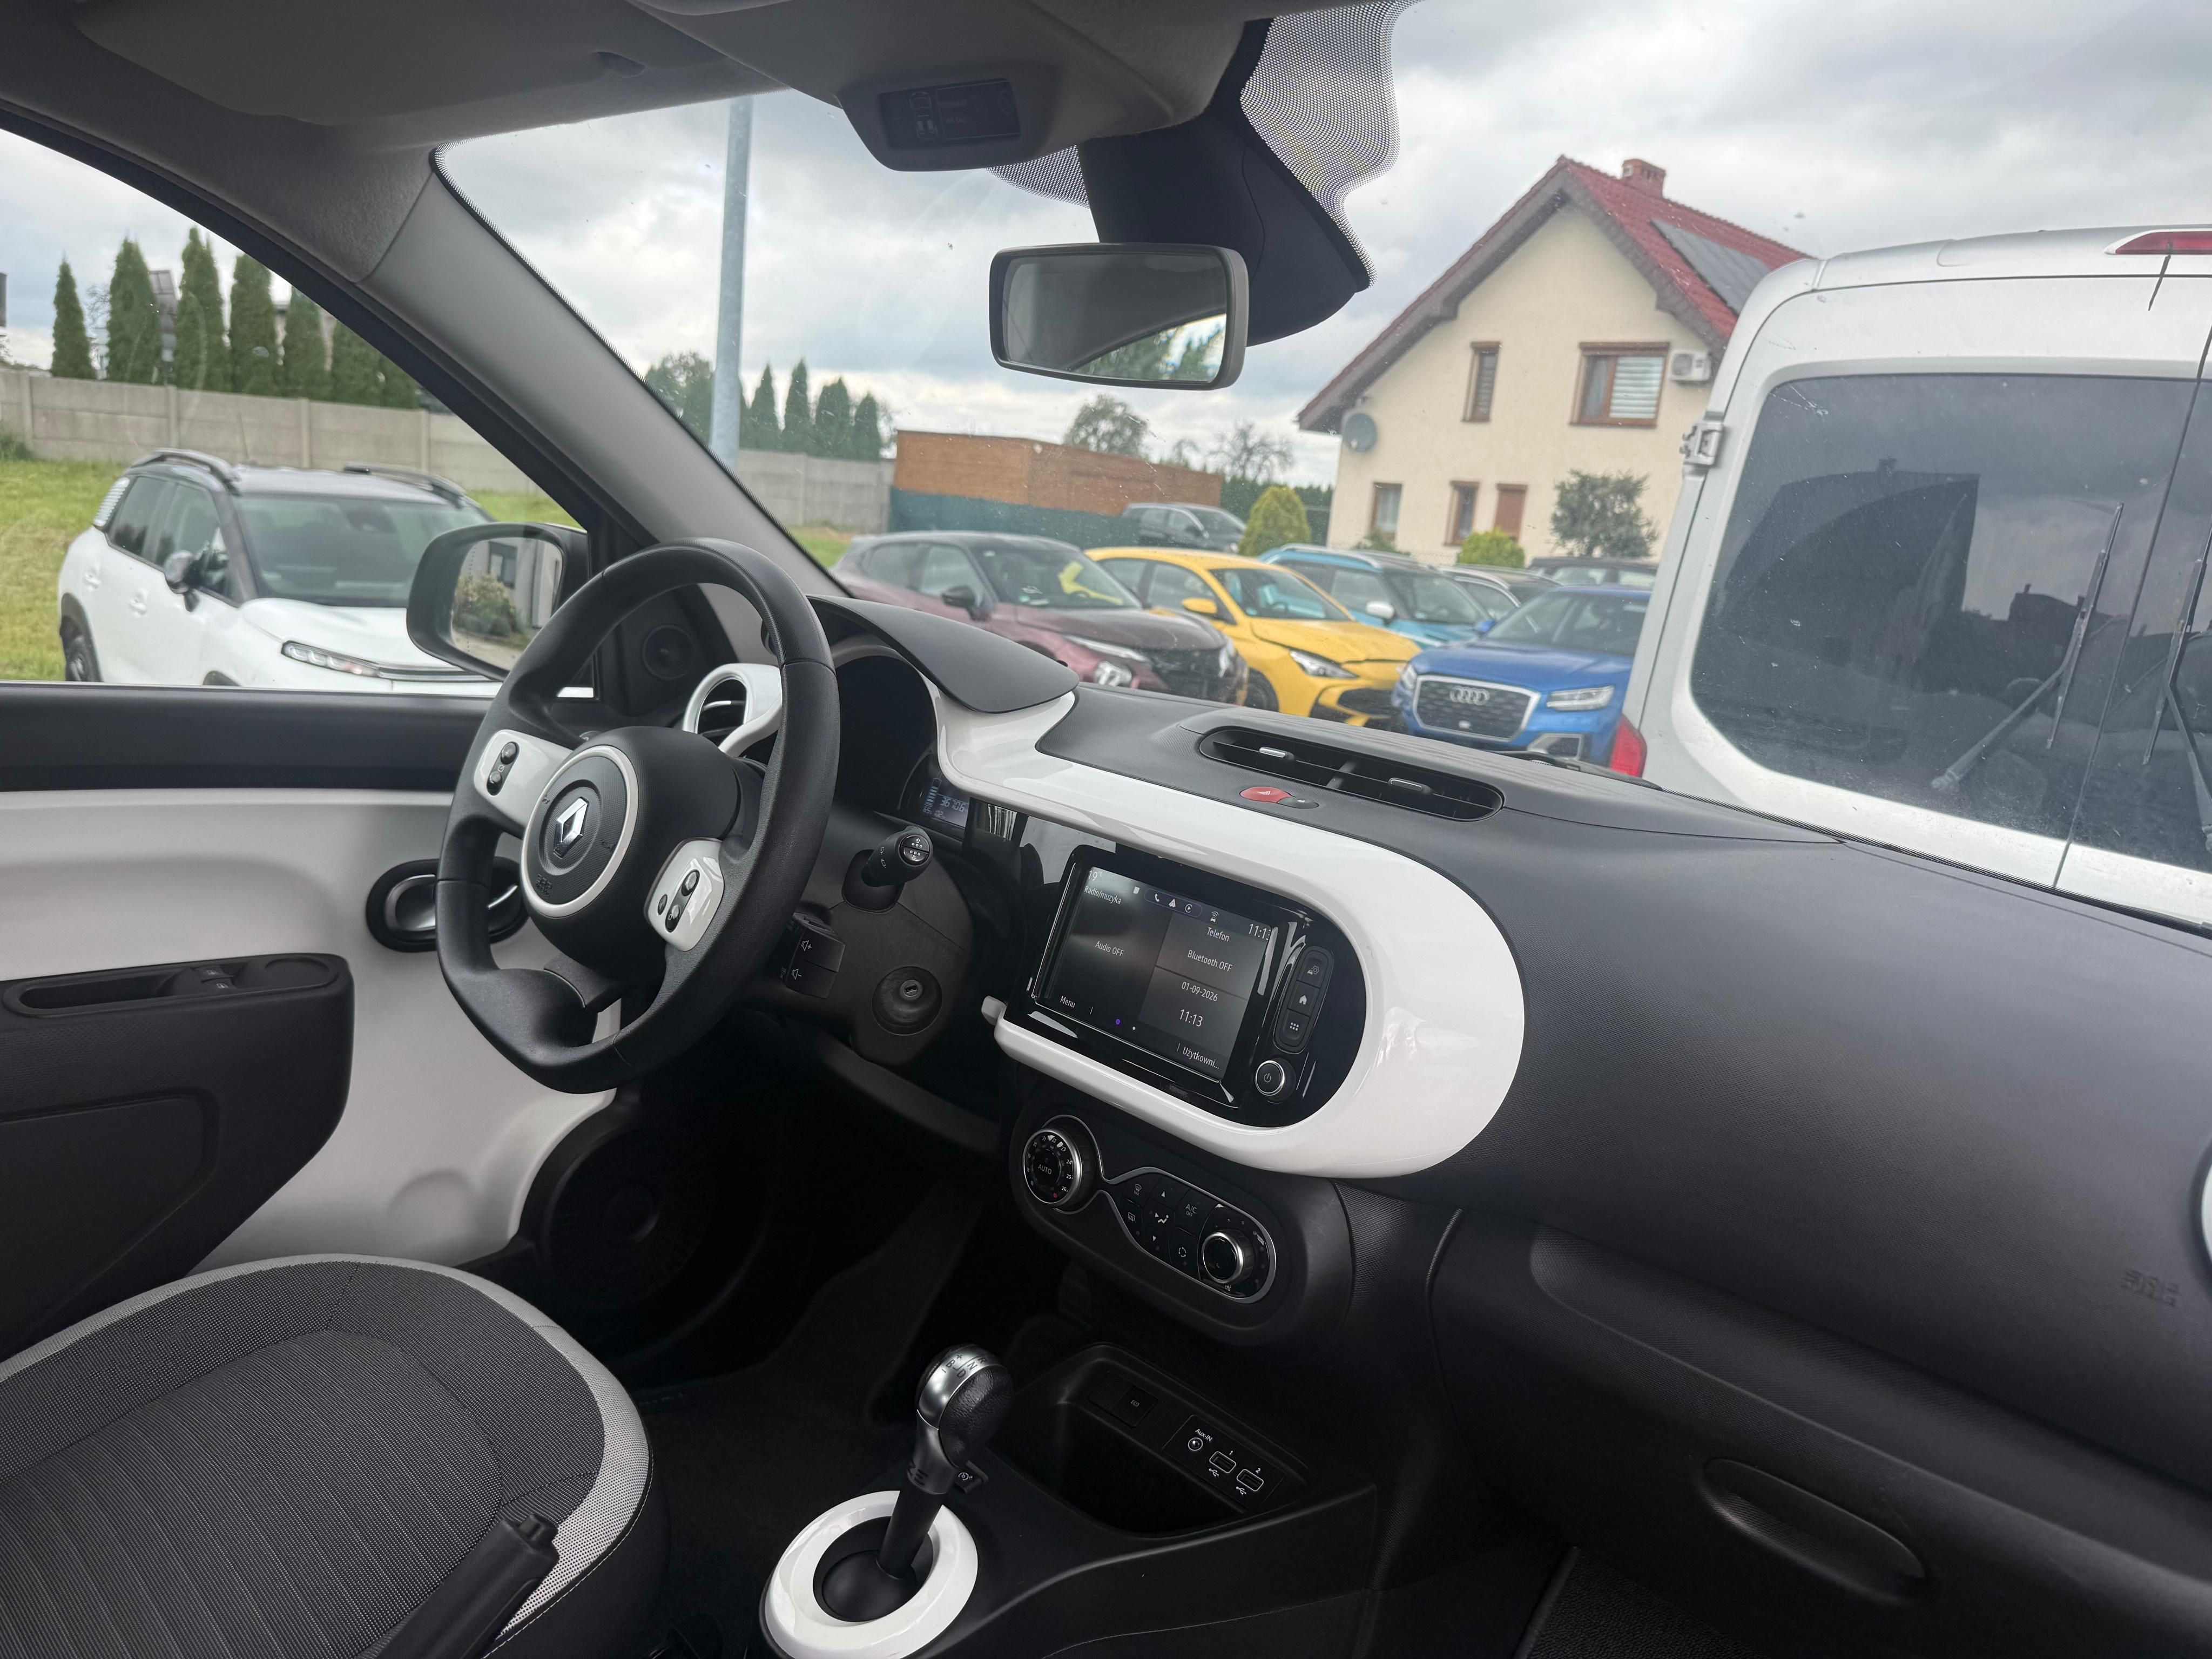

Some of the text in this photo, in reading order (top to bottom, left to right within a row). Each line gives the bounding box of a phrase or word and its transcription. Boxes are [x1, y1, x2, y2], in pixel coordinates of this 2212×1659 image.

[1084, 885, 1122, 905] Radio/muzyka
[1207, 927, 1230, 942] Telefon
[1095, 941, 1124, 956] Audio OFF
[1188, 949, 1233, 972] Bluetooth OFF
[1181, 981, 1218, 1002] 01-09-2026
[1060, 995, 1076, 1008] Menu
[1179, 1009, 1203, 1027] 11:13
[1038, 1164, 1052, 1175] AUTO
[1185, 1203, 1197, 1214] A/C
[946, 1359, 955, 1367] B
[967, 1361, 977, 1370] N
[956, 1369, 966, 1378] D
